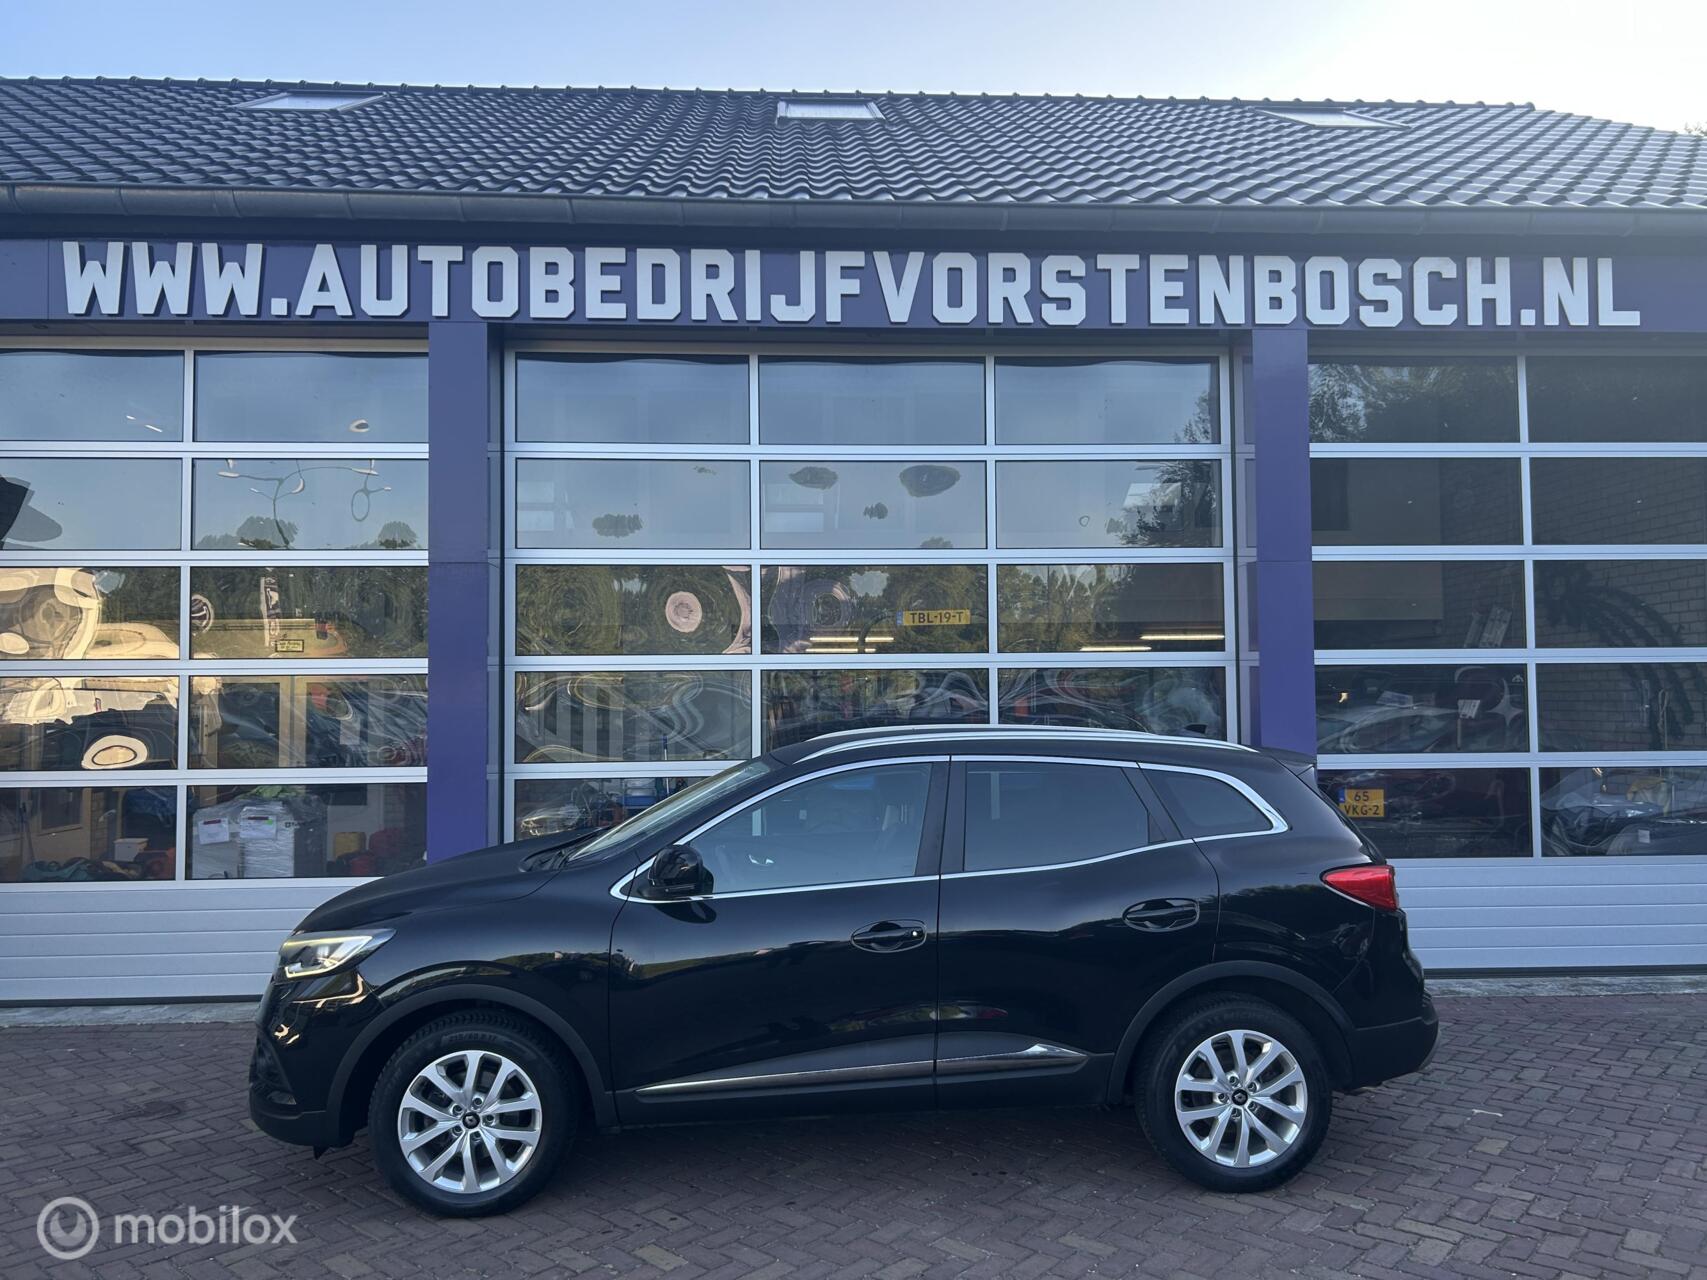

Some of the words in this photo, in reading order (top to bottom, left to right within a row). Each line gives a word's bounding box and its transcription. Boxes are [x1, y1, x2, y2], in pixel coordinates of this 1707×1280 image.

[62, 241, 1641, 328] WWW.AUTOBEDRIJFVORSTENBOSCH.NL
[910, 612, 964, 624] TBL-19-T
[1354, 791, 1370, 802] 65
[1344, 804, 1380, 816] VKG-2
